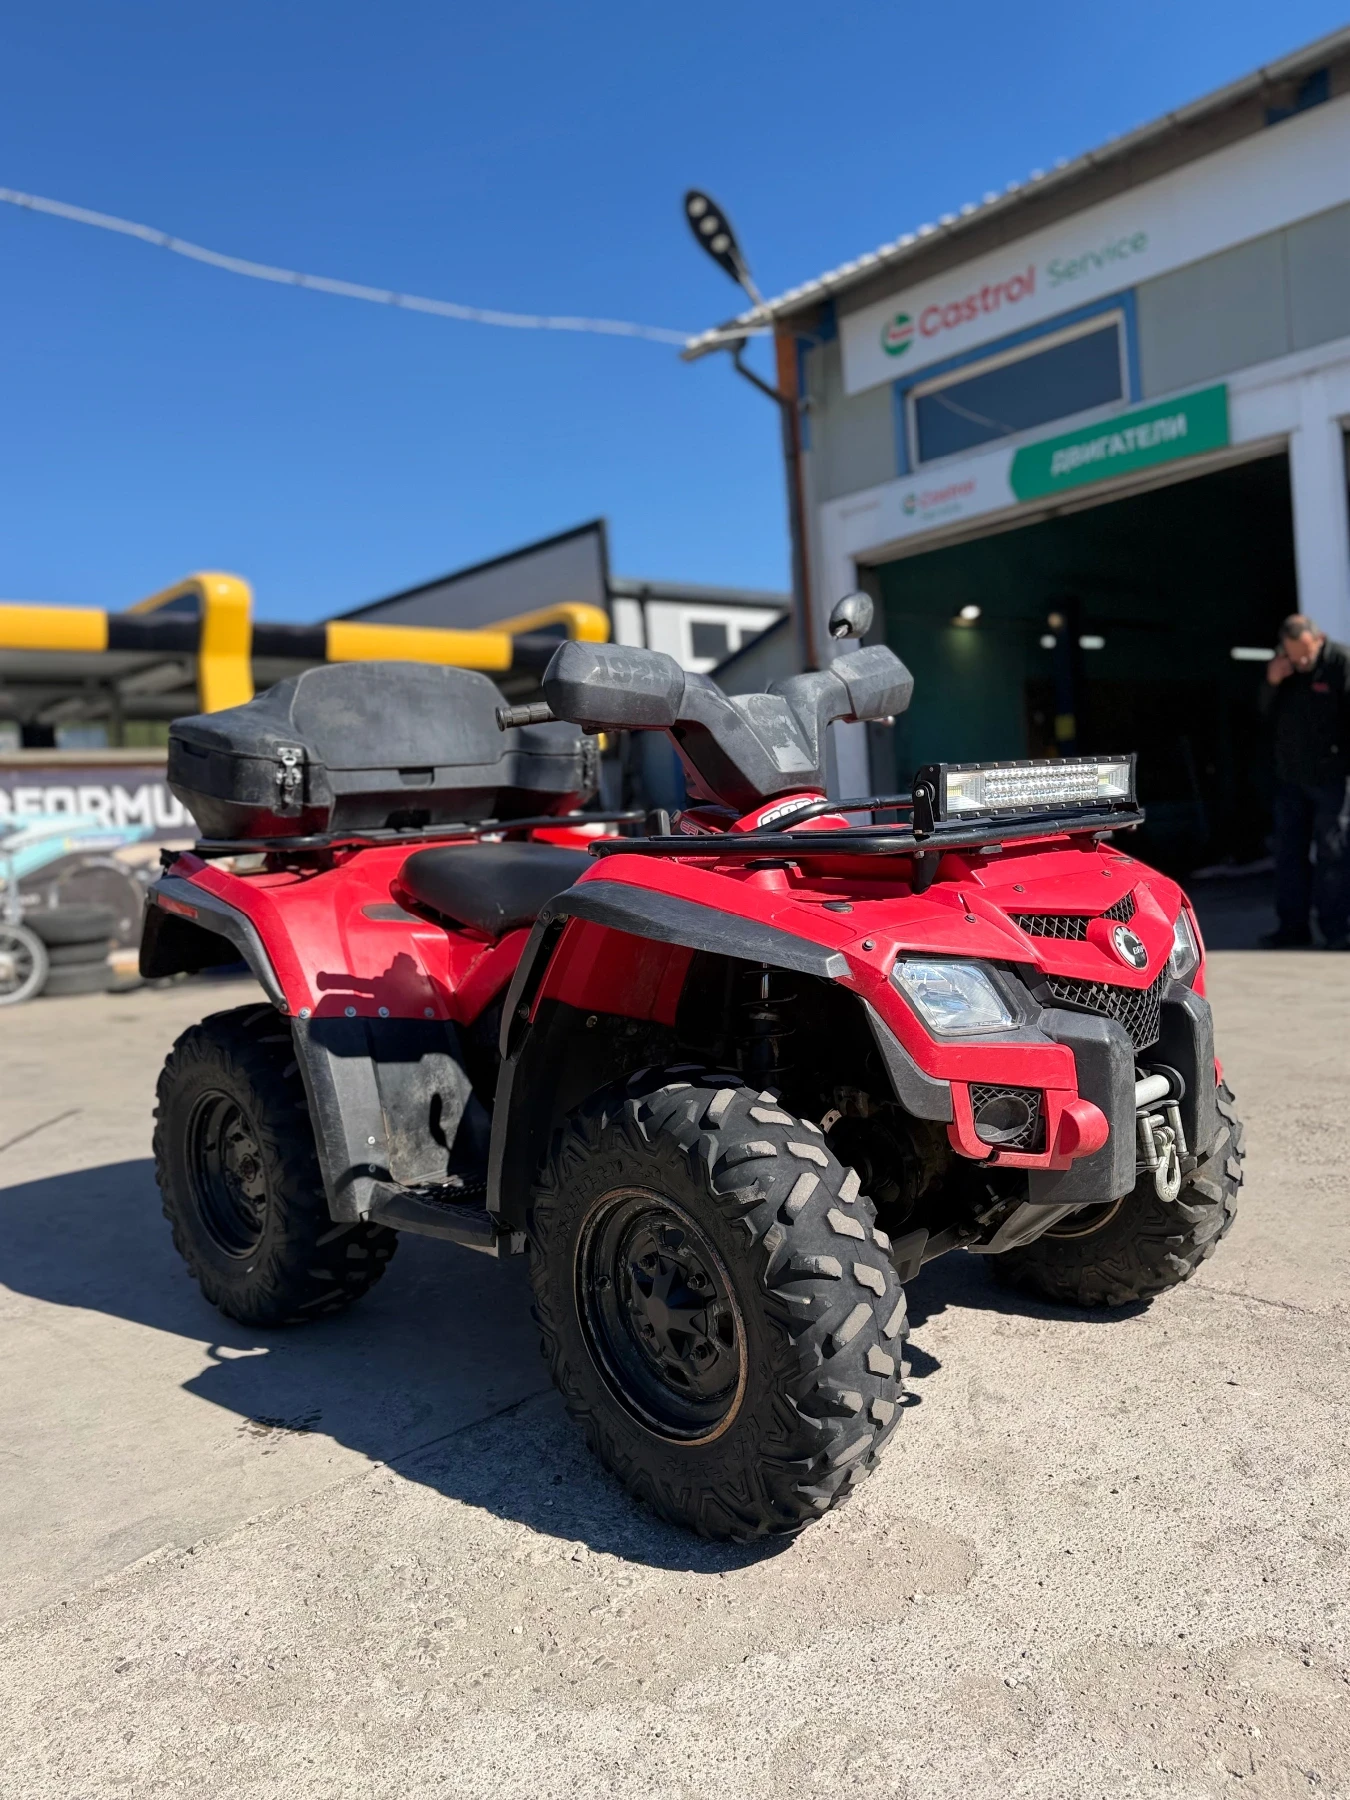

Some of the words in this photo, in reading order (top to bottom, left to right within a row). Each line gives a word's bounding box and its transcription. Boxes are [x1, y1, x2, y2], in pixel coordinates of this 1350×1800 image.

[918, 264, 1036, 338] Castrol
[1047, 231, 1148, 288] Service
[1050, 412, 1187, 478] ДВИГАТЕЛИ
[0, 784, 196, 828] FORMU
